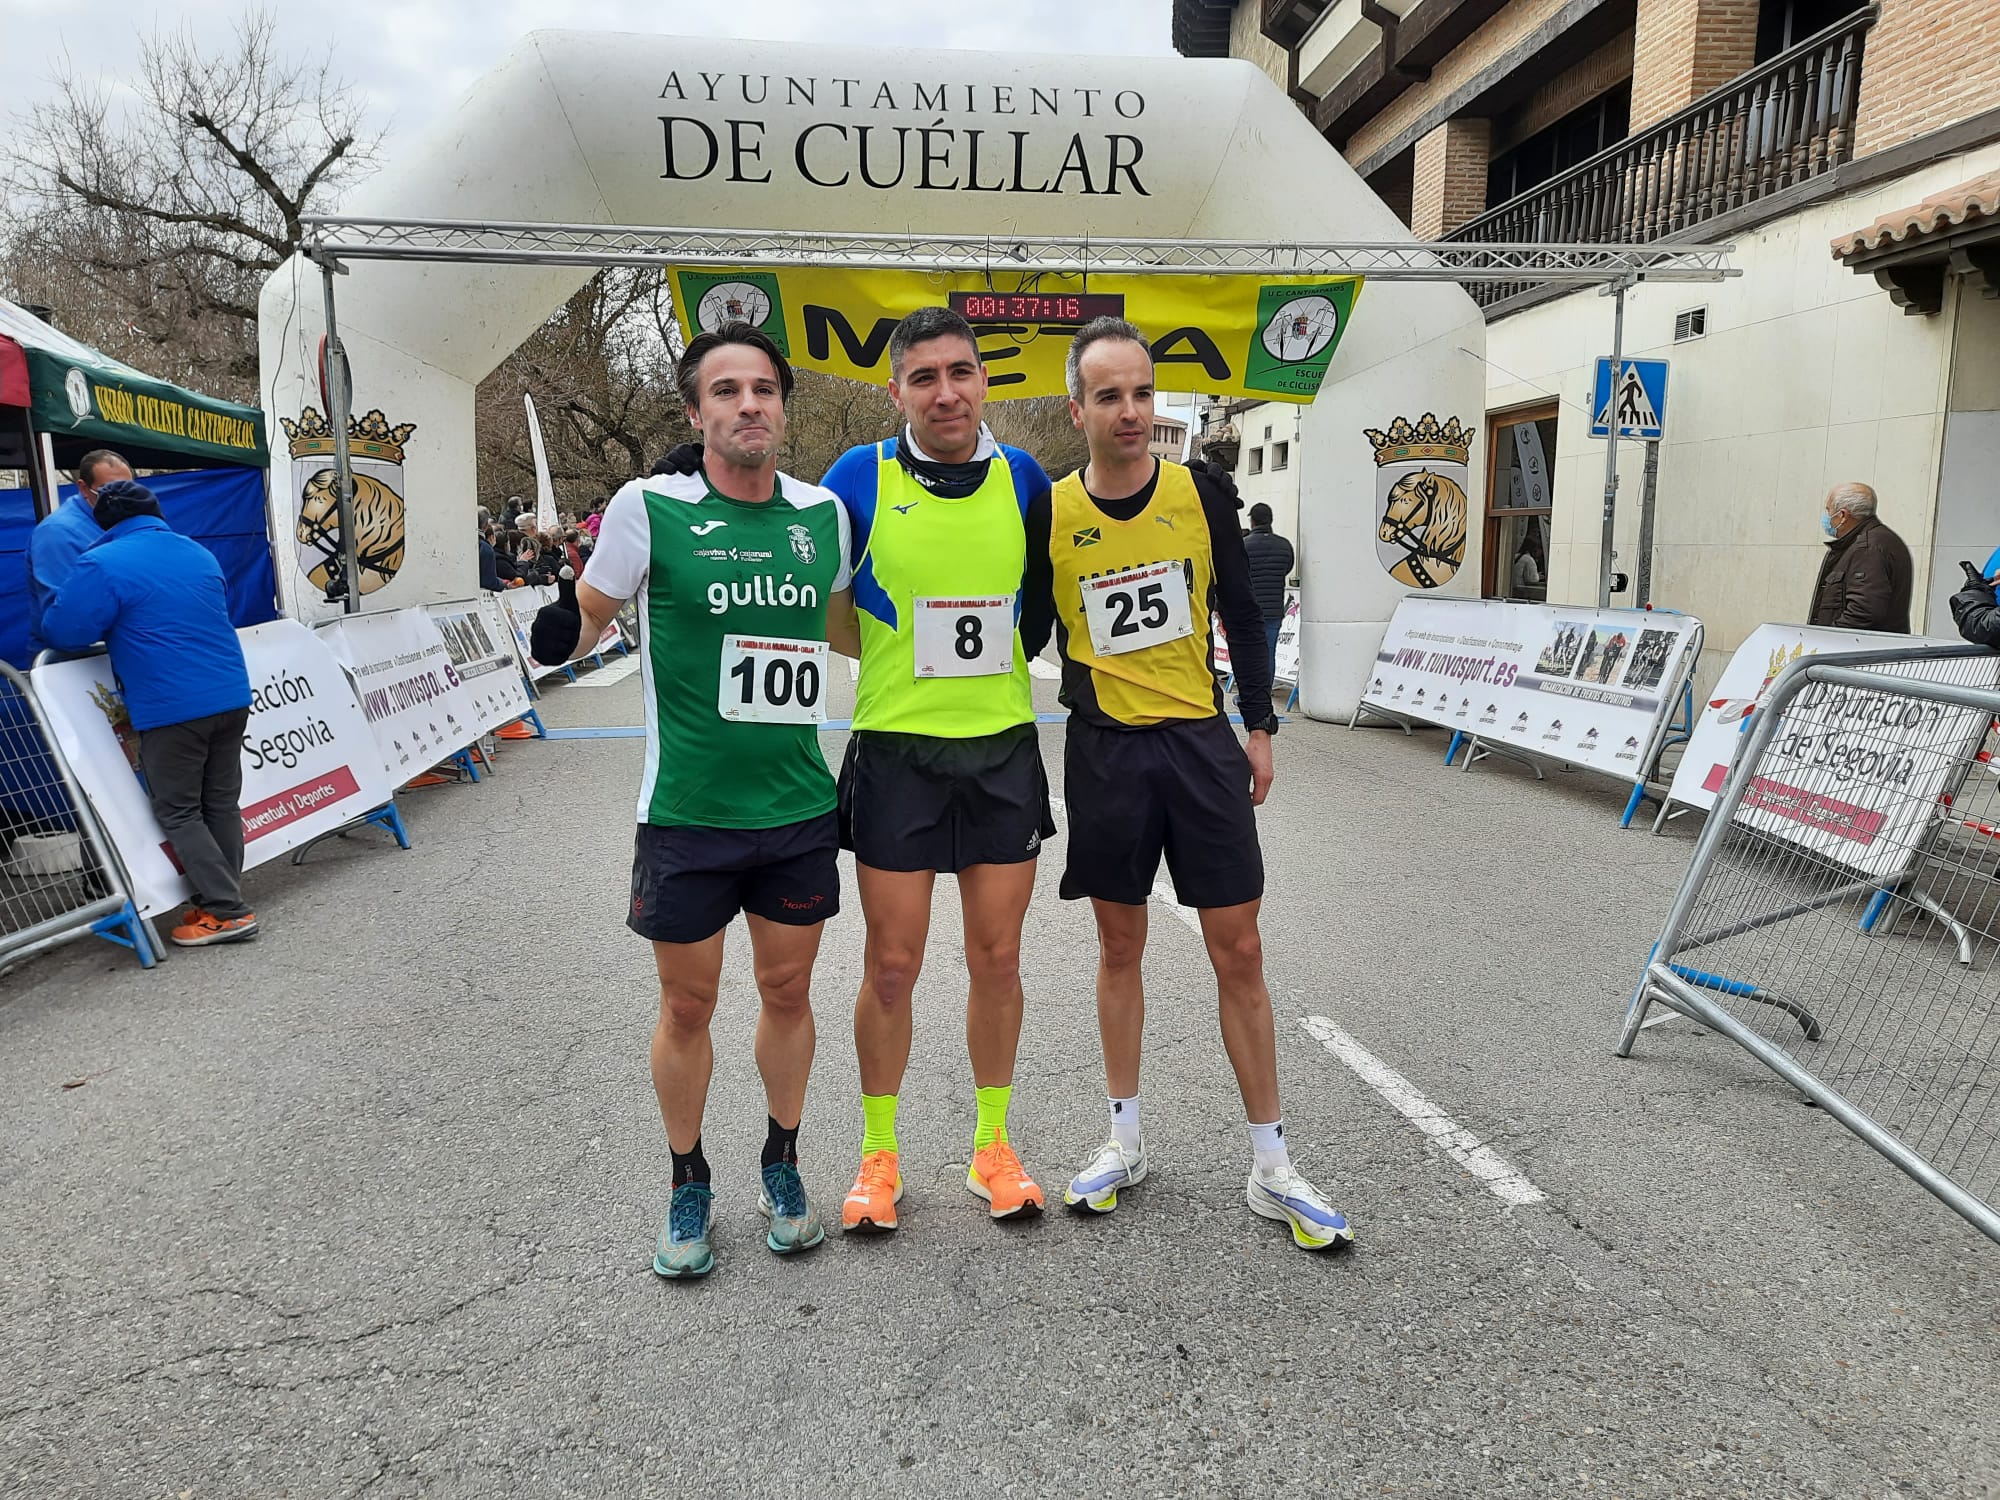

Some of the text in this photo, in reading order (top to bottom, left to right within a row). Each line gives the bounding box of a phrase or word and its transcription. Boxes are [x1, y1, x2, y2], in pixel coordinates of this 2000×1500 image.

[657, 70, 1146, 119] AYUNTAMIENTO
[657, 116, 1153, 196] DE CUÉLLAR
[966, 296, 1080, 319] 00:37:16
[1277, 380, 1321, 390] DE CICLISM
[137, 394, 185, 437] CICLISTA
[187, 407, 257, 450] CANTIMPALOS
[707, 574, 817, 615] gullón
[1105, 582, 1169, 638] 25
[955, 615, 983, 660] 8
[731, 655, 820, 708] 100
[1392, 647, 1519, 688] www.runvasport.es
[241, 715, 335, 769] Segovia
[1814, 730, 1915, 786] Segovia
[241, 783, 336, 832] Juventud y Deportes
